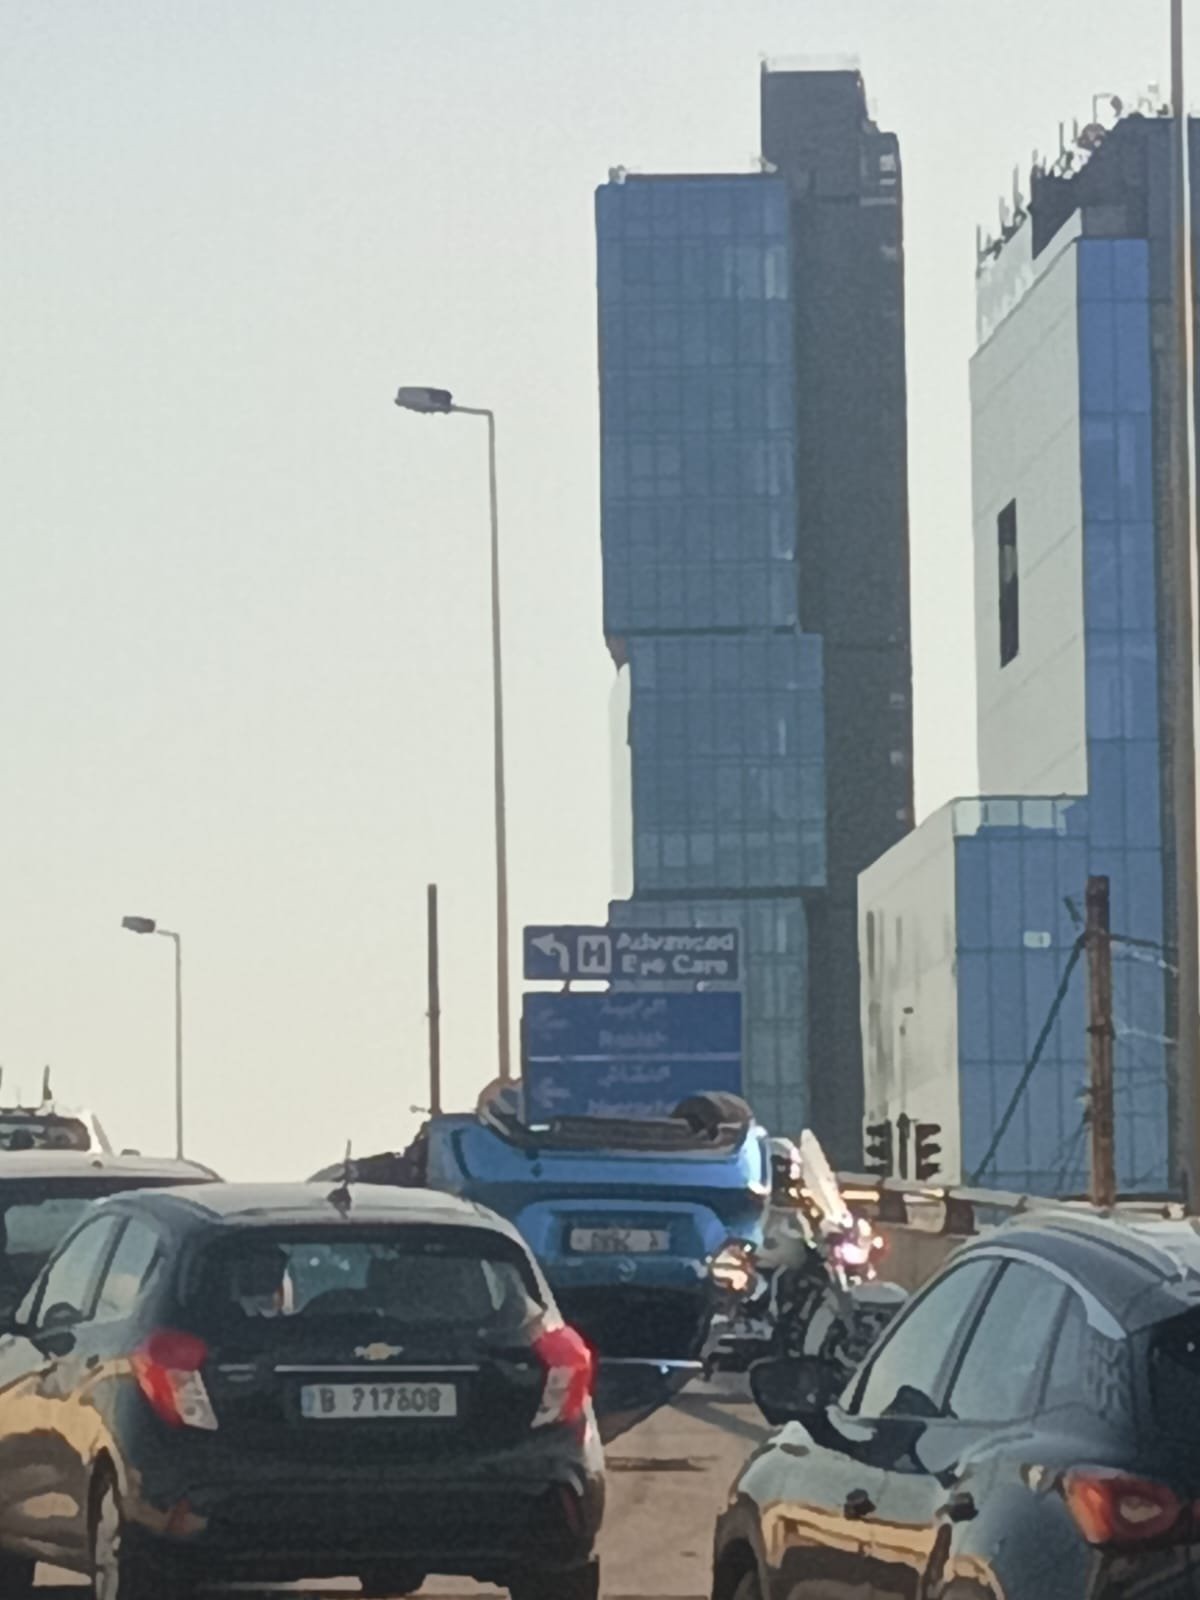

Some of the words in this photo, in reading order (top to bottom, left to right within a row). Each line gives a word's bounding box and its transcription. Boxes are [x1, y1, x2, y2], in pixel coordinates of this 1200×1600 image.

[616, 932, 734, 950] Advanced
[622, 954, 666, 976] Eye
[672, 954, 728, 975] Care
[319, 1387, 336, 1413] B
